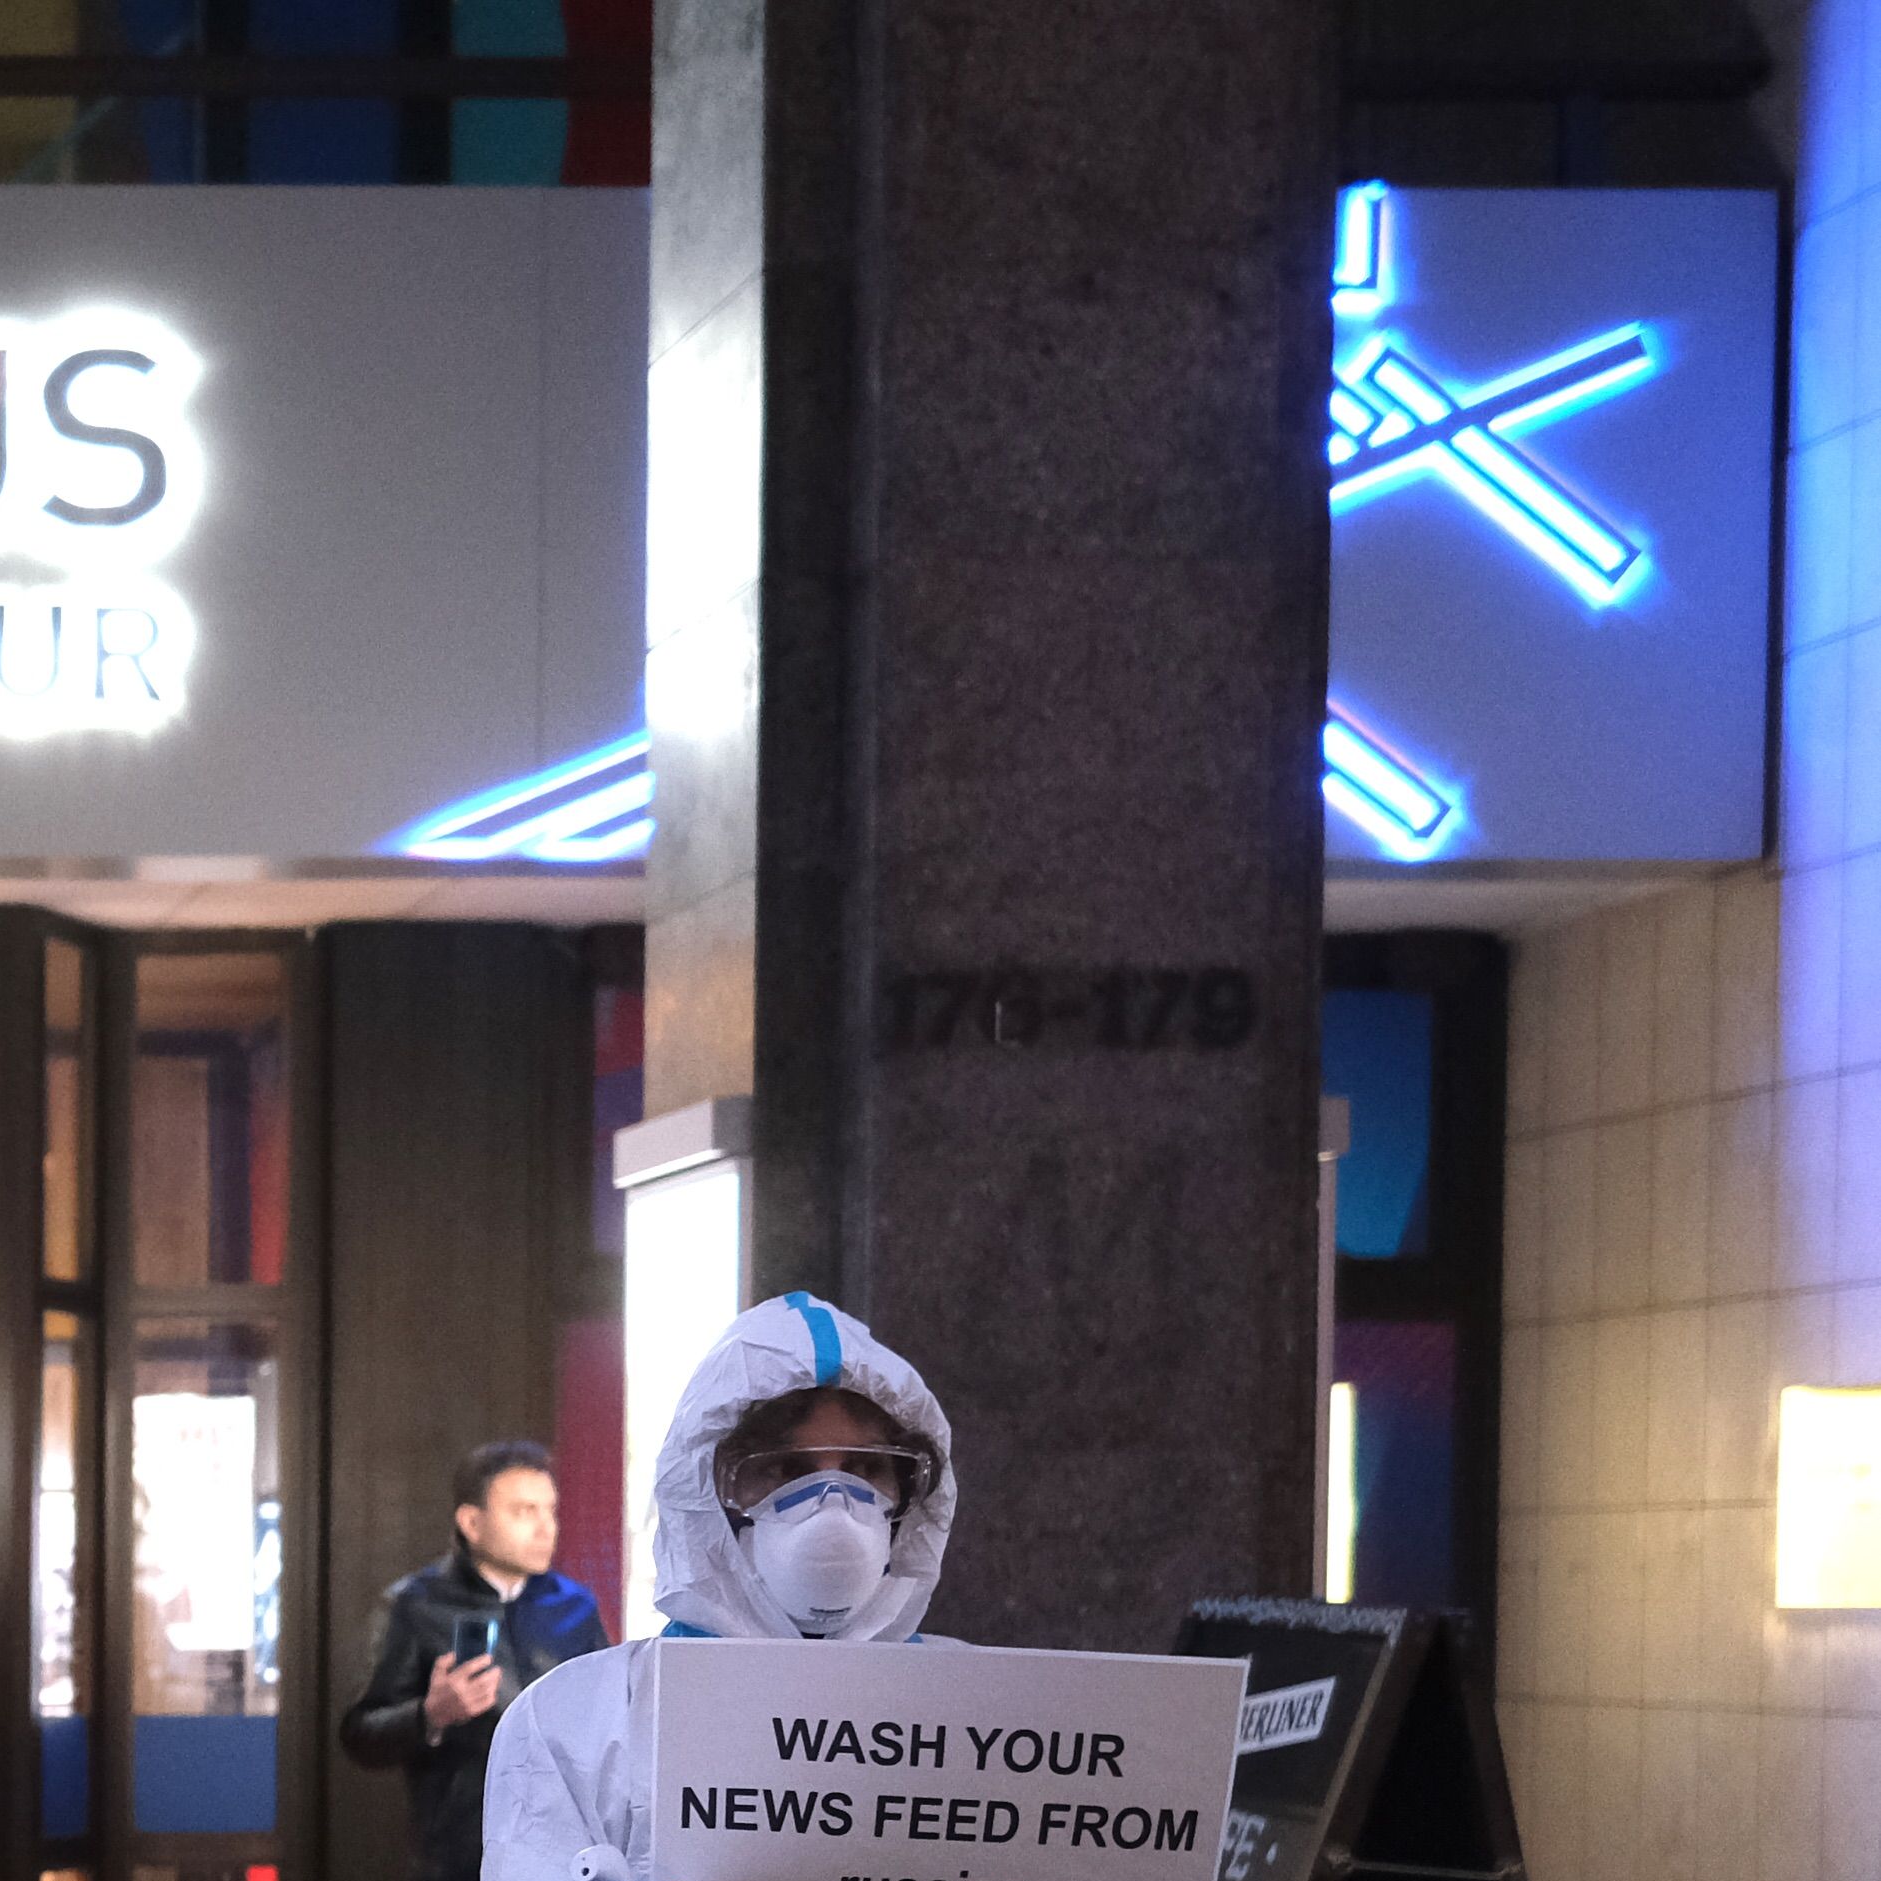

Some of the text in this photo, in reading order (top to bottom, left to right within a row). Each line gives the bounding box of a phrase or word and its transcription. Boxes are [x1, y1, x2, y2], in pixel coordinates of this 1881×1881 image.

[772, 1716, 1125, 1778] WASH YOUR
[679, 1786, 1200, 1852] NEWS FEED FROM
